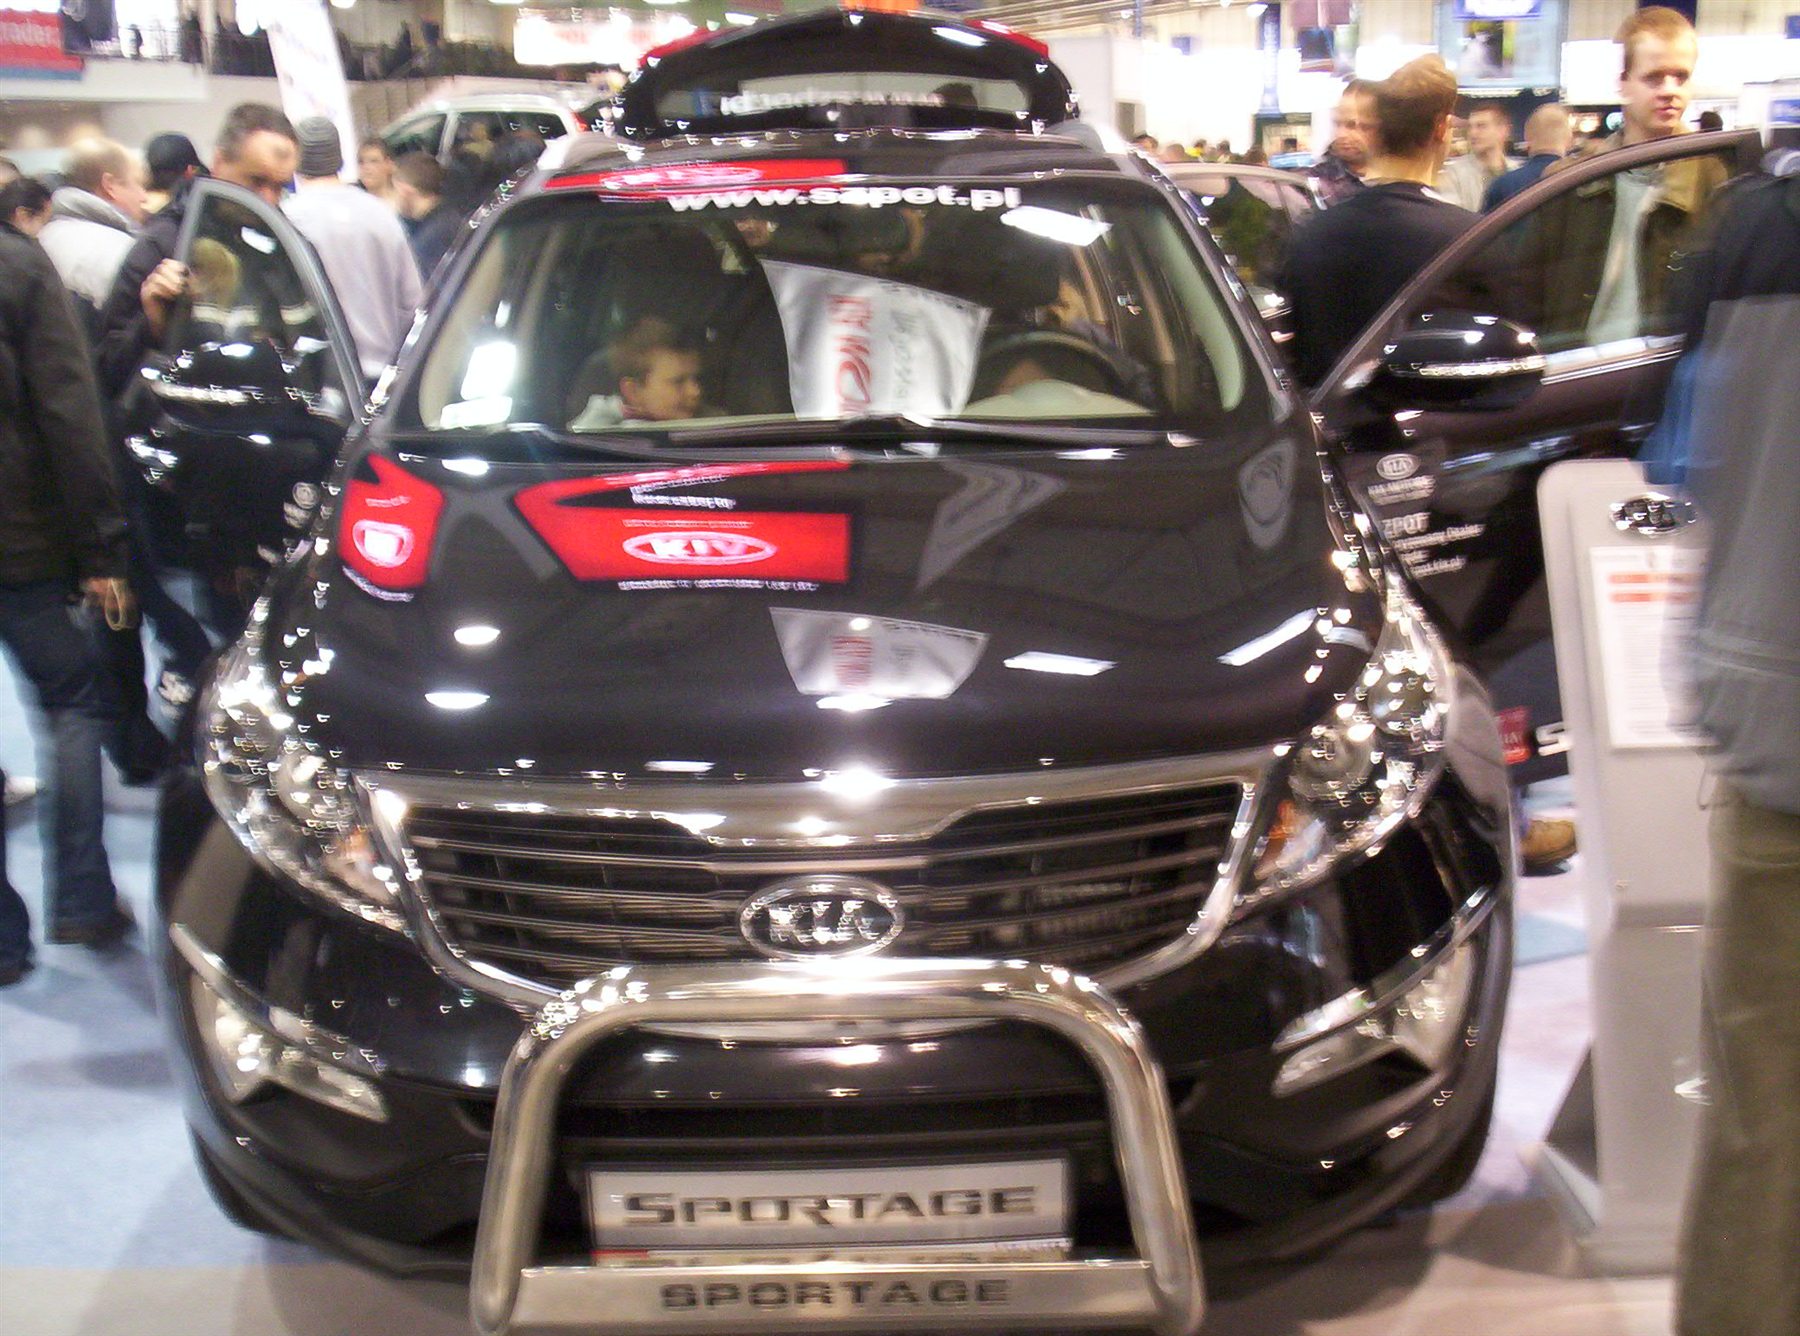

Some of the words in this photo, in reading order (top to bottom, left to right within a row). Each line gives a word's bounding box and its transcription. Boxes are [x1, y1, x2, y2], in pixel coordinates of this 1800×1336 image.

[667, 185, 1021, 212] www.szpot.pl
[622, 1186, 1039, 1227] SPORTAGE
[660, 1278, 1011, 1311] SPORTAGE
